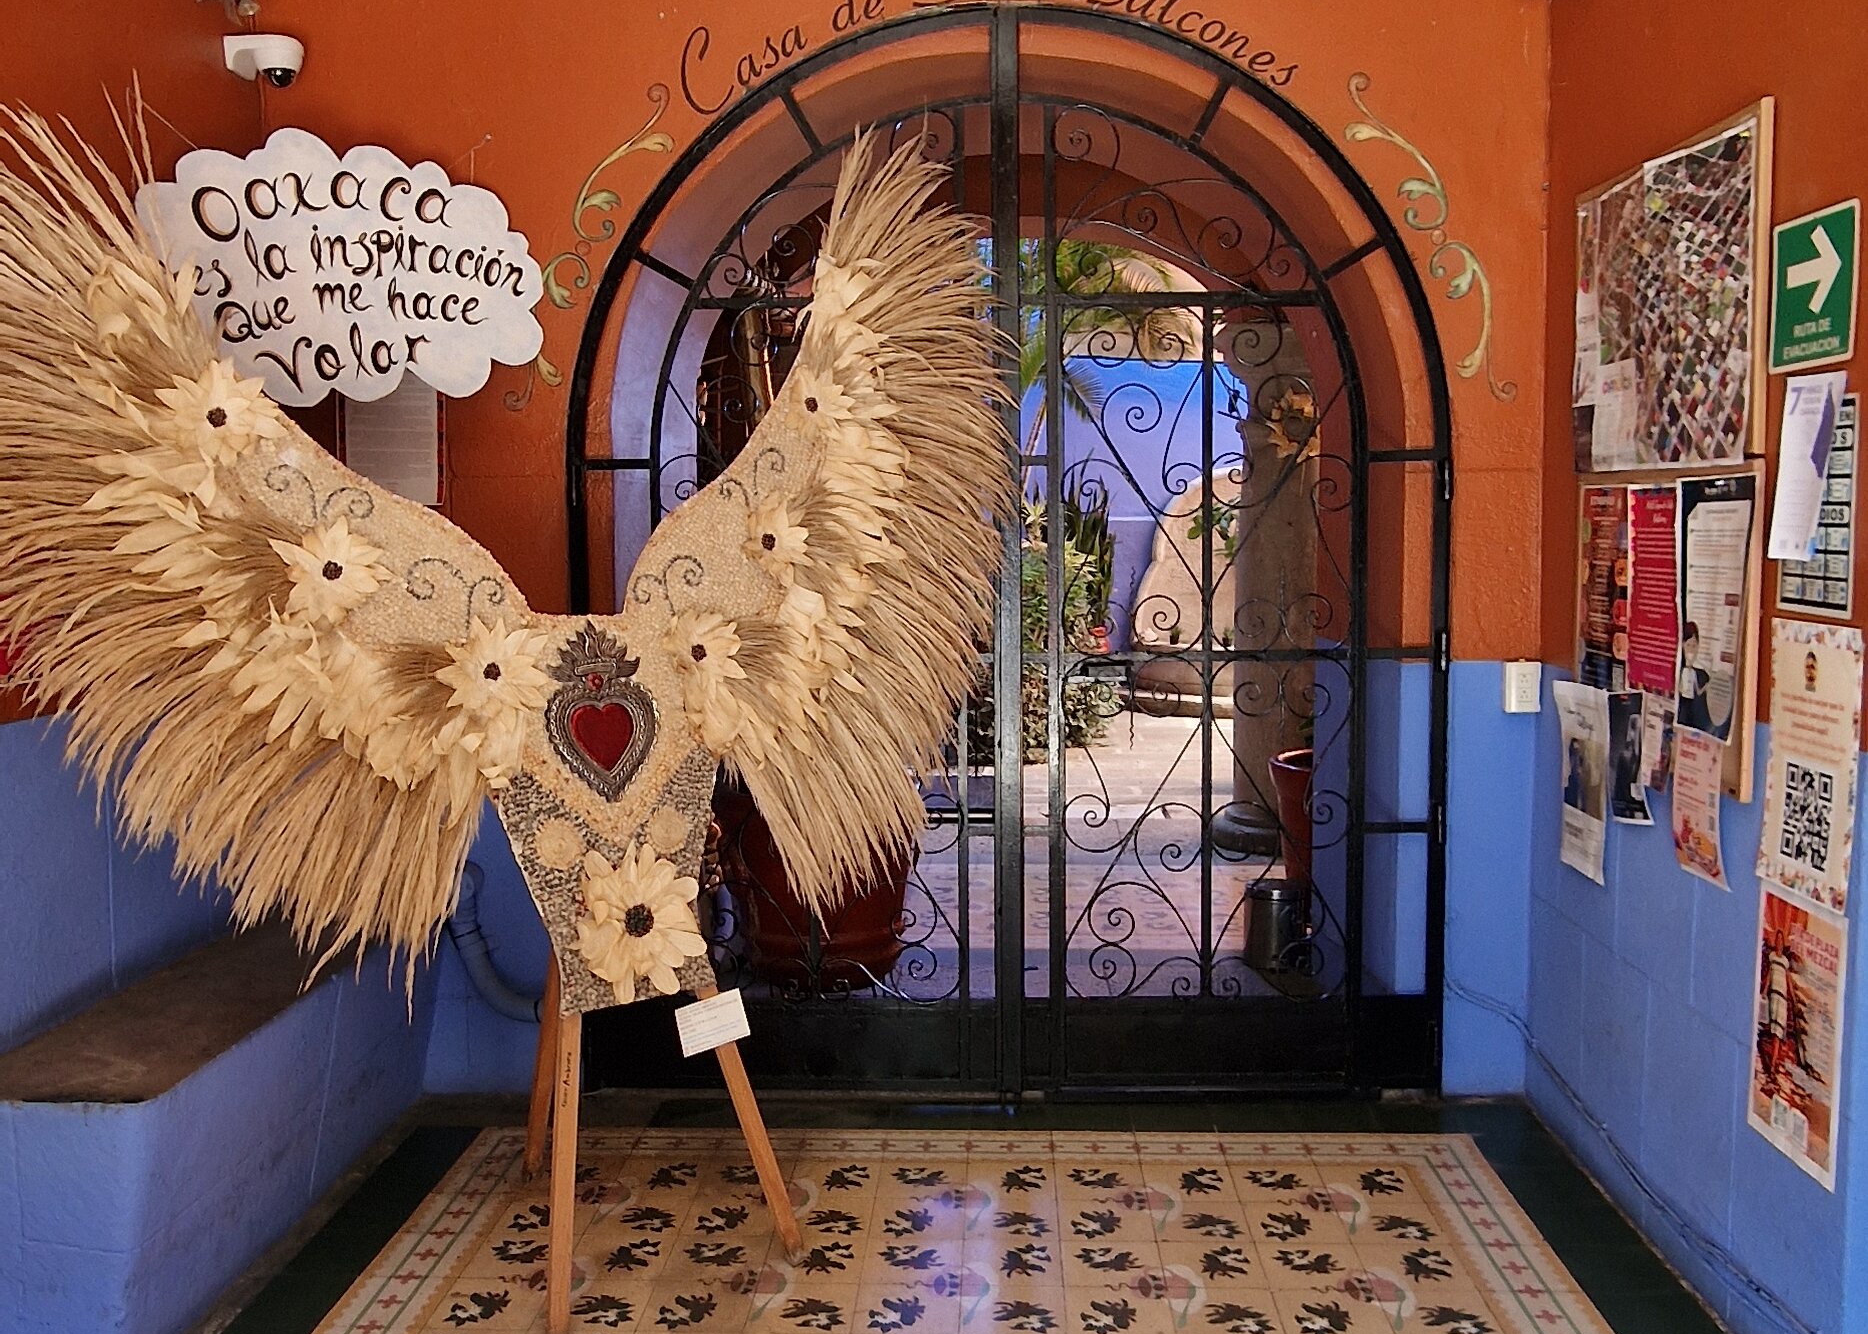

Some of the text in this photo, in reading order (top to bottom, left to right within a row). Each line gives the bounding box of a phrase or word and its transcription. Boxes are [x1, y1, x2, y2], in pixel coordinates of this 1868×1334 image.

[678, 26, 808, 115] Casa
[191, 171, 452, 242] Oaxaca
[244, 227, 298, 287] la
[310, 224, 525, 297] inspiración
[213, 276, 489, 344] Que me hace
[1789, 386, 1804, 415] 7
[1819, 507, 1845, 521] DIOS
